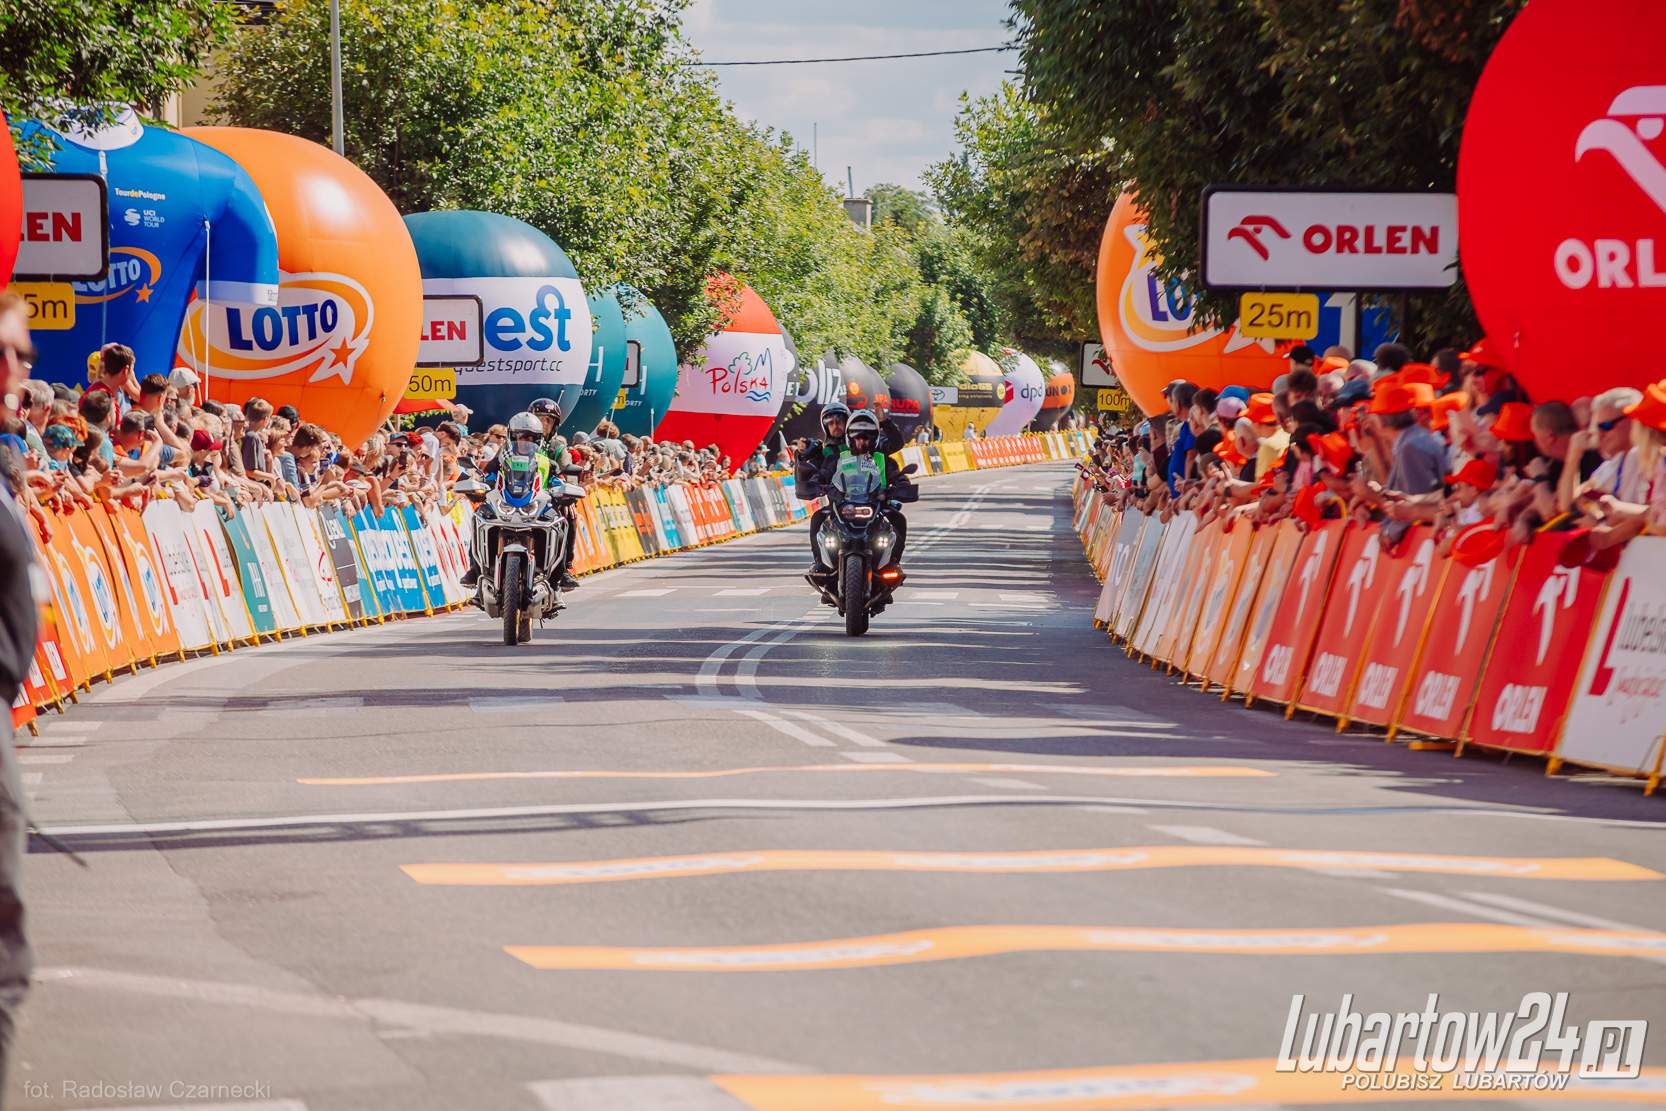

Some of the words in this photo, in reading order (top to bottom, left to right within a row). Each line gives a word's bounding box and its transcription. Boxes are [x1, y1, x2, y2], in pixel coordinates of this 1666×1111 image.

[20, 212, 82, 242] EN
[143, 215, 165, 224] WORLD
[143, 221, 160, 229] TOUR
[1303, 224, 1439, 254] ORLEN
[71, 258, 141, 292] TTO
[1554, 238, 1666, 289] ORL
[226, 299, 338, 351] LOTTO
[1249, 302, 1312, 329] 25m
[408, 375, 452, 392] 50m
